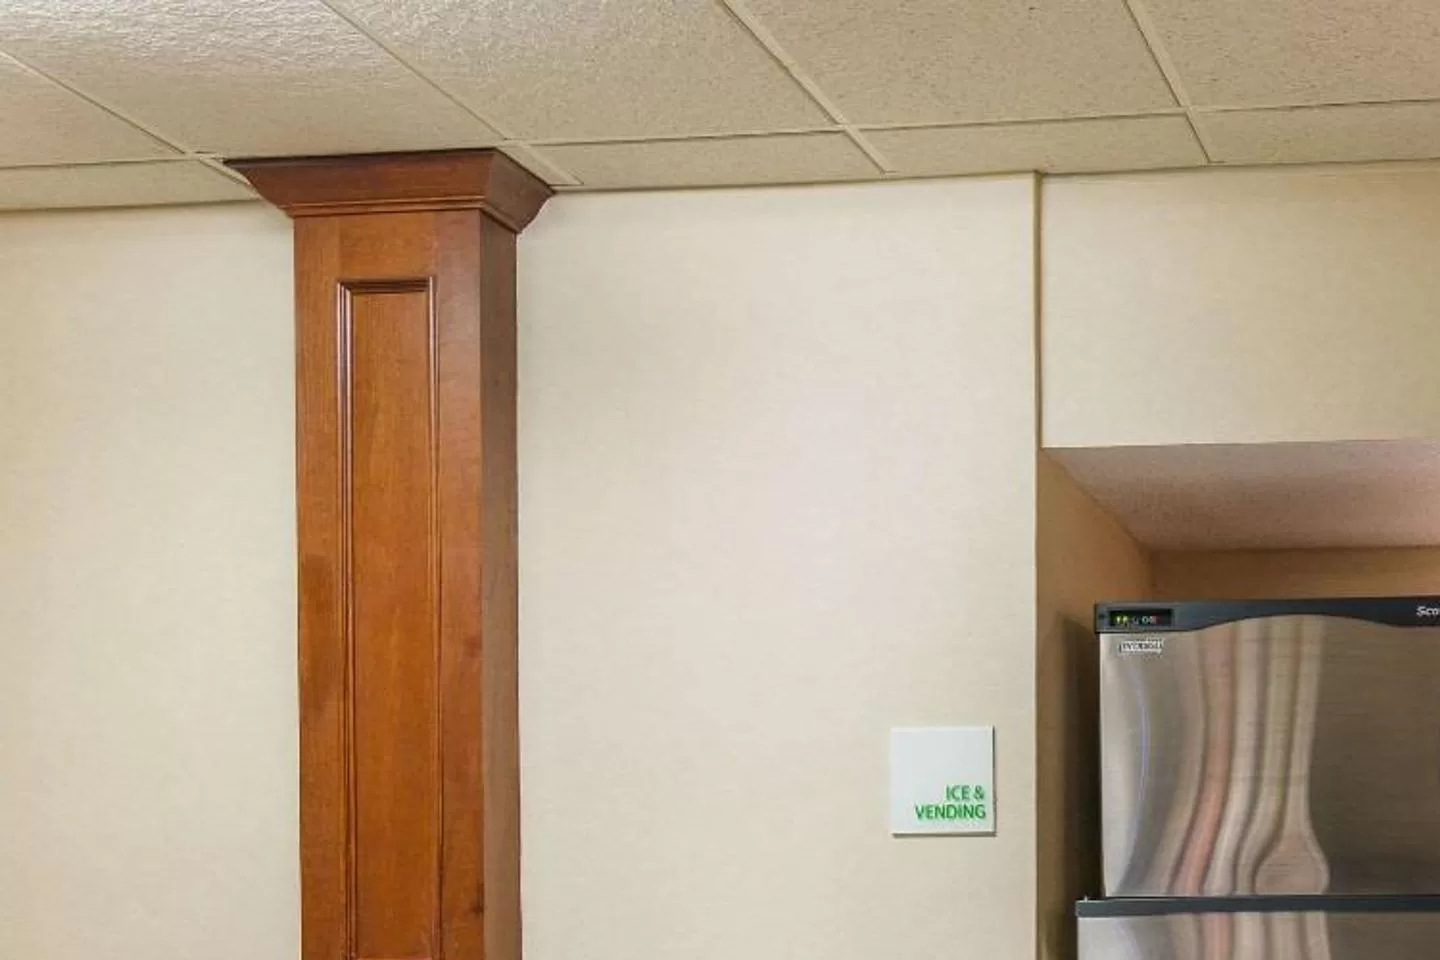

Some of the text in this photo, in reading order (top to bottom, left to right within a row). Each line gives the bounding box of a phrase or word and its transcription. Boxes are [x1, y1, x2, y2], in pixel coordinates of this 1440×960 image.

[946, 784, 984, 800] ICE &
[914, 803, 986, 820] VENDING
